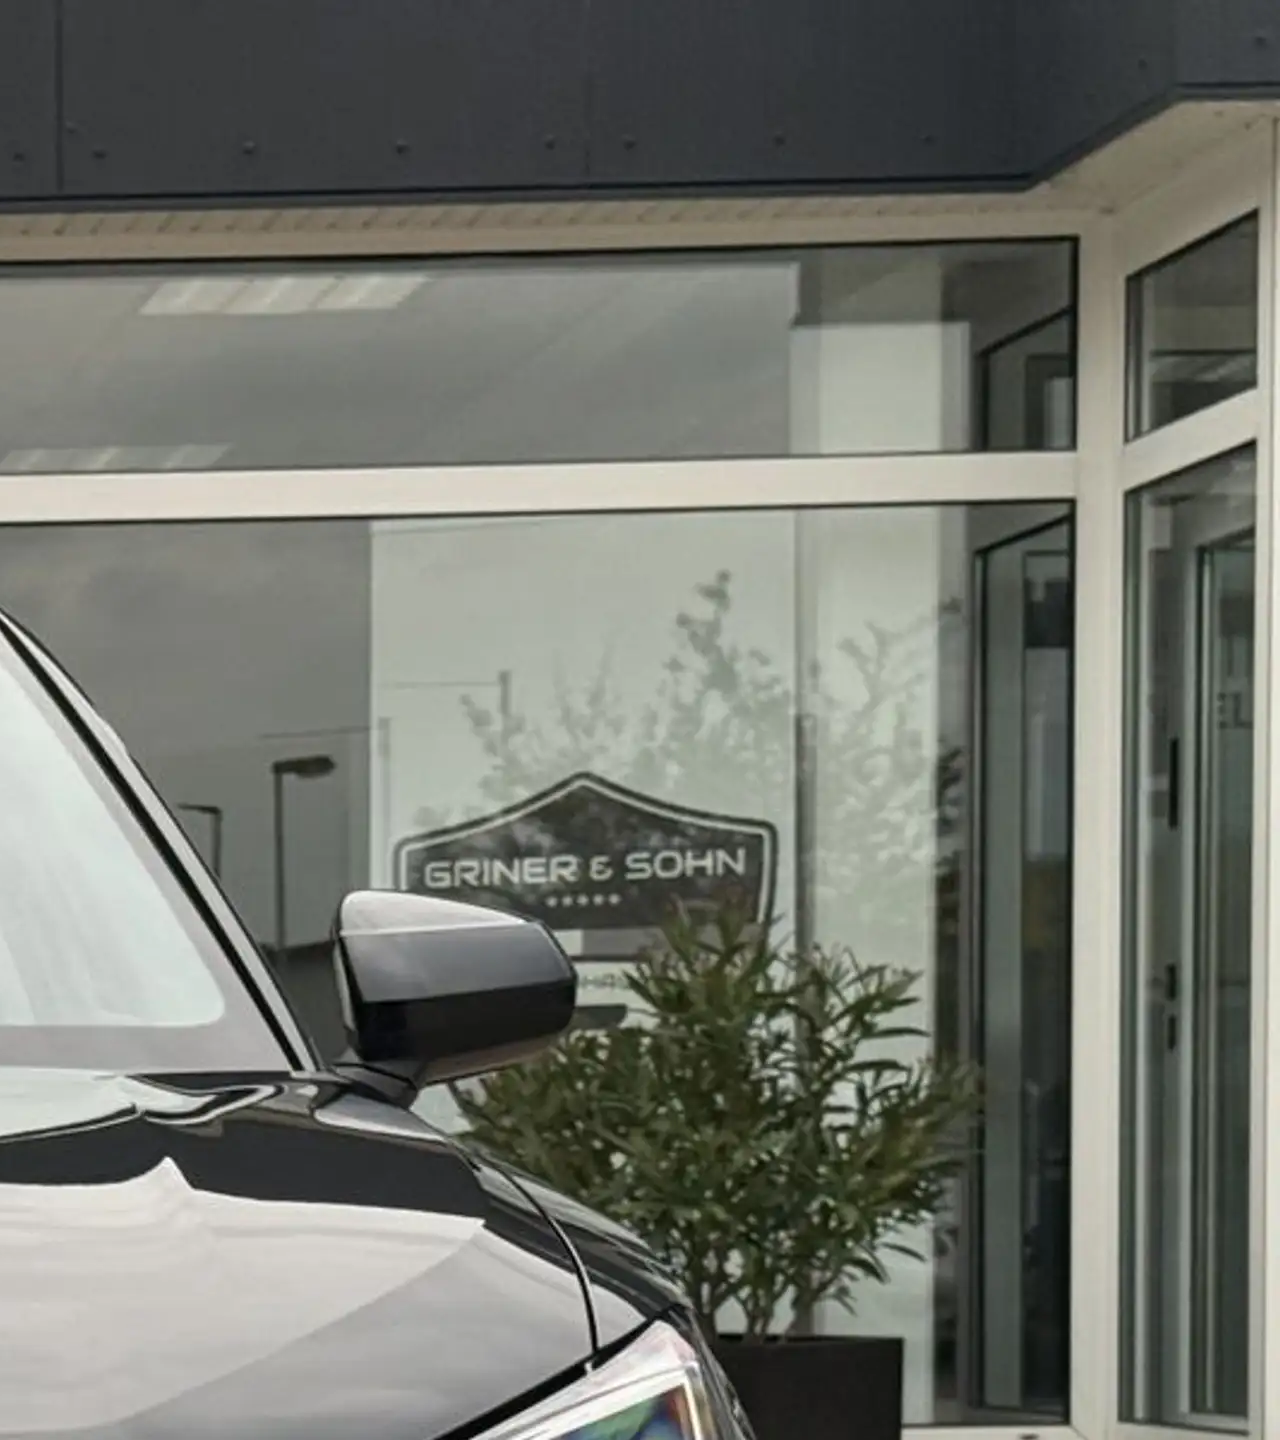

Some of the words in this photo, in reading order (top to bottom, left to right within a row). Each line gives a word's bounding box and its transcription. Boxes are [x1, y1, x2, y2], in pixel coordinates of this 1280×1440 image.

[423, 854, 580, 889] GRINER
[589, 857, 613, 881] &
[624, 847, 747, 881] SOHN
